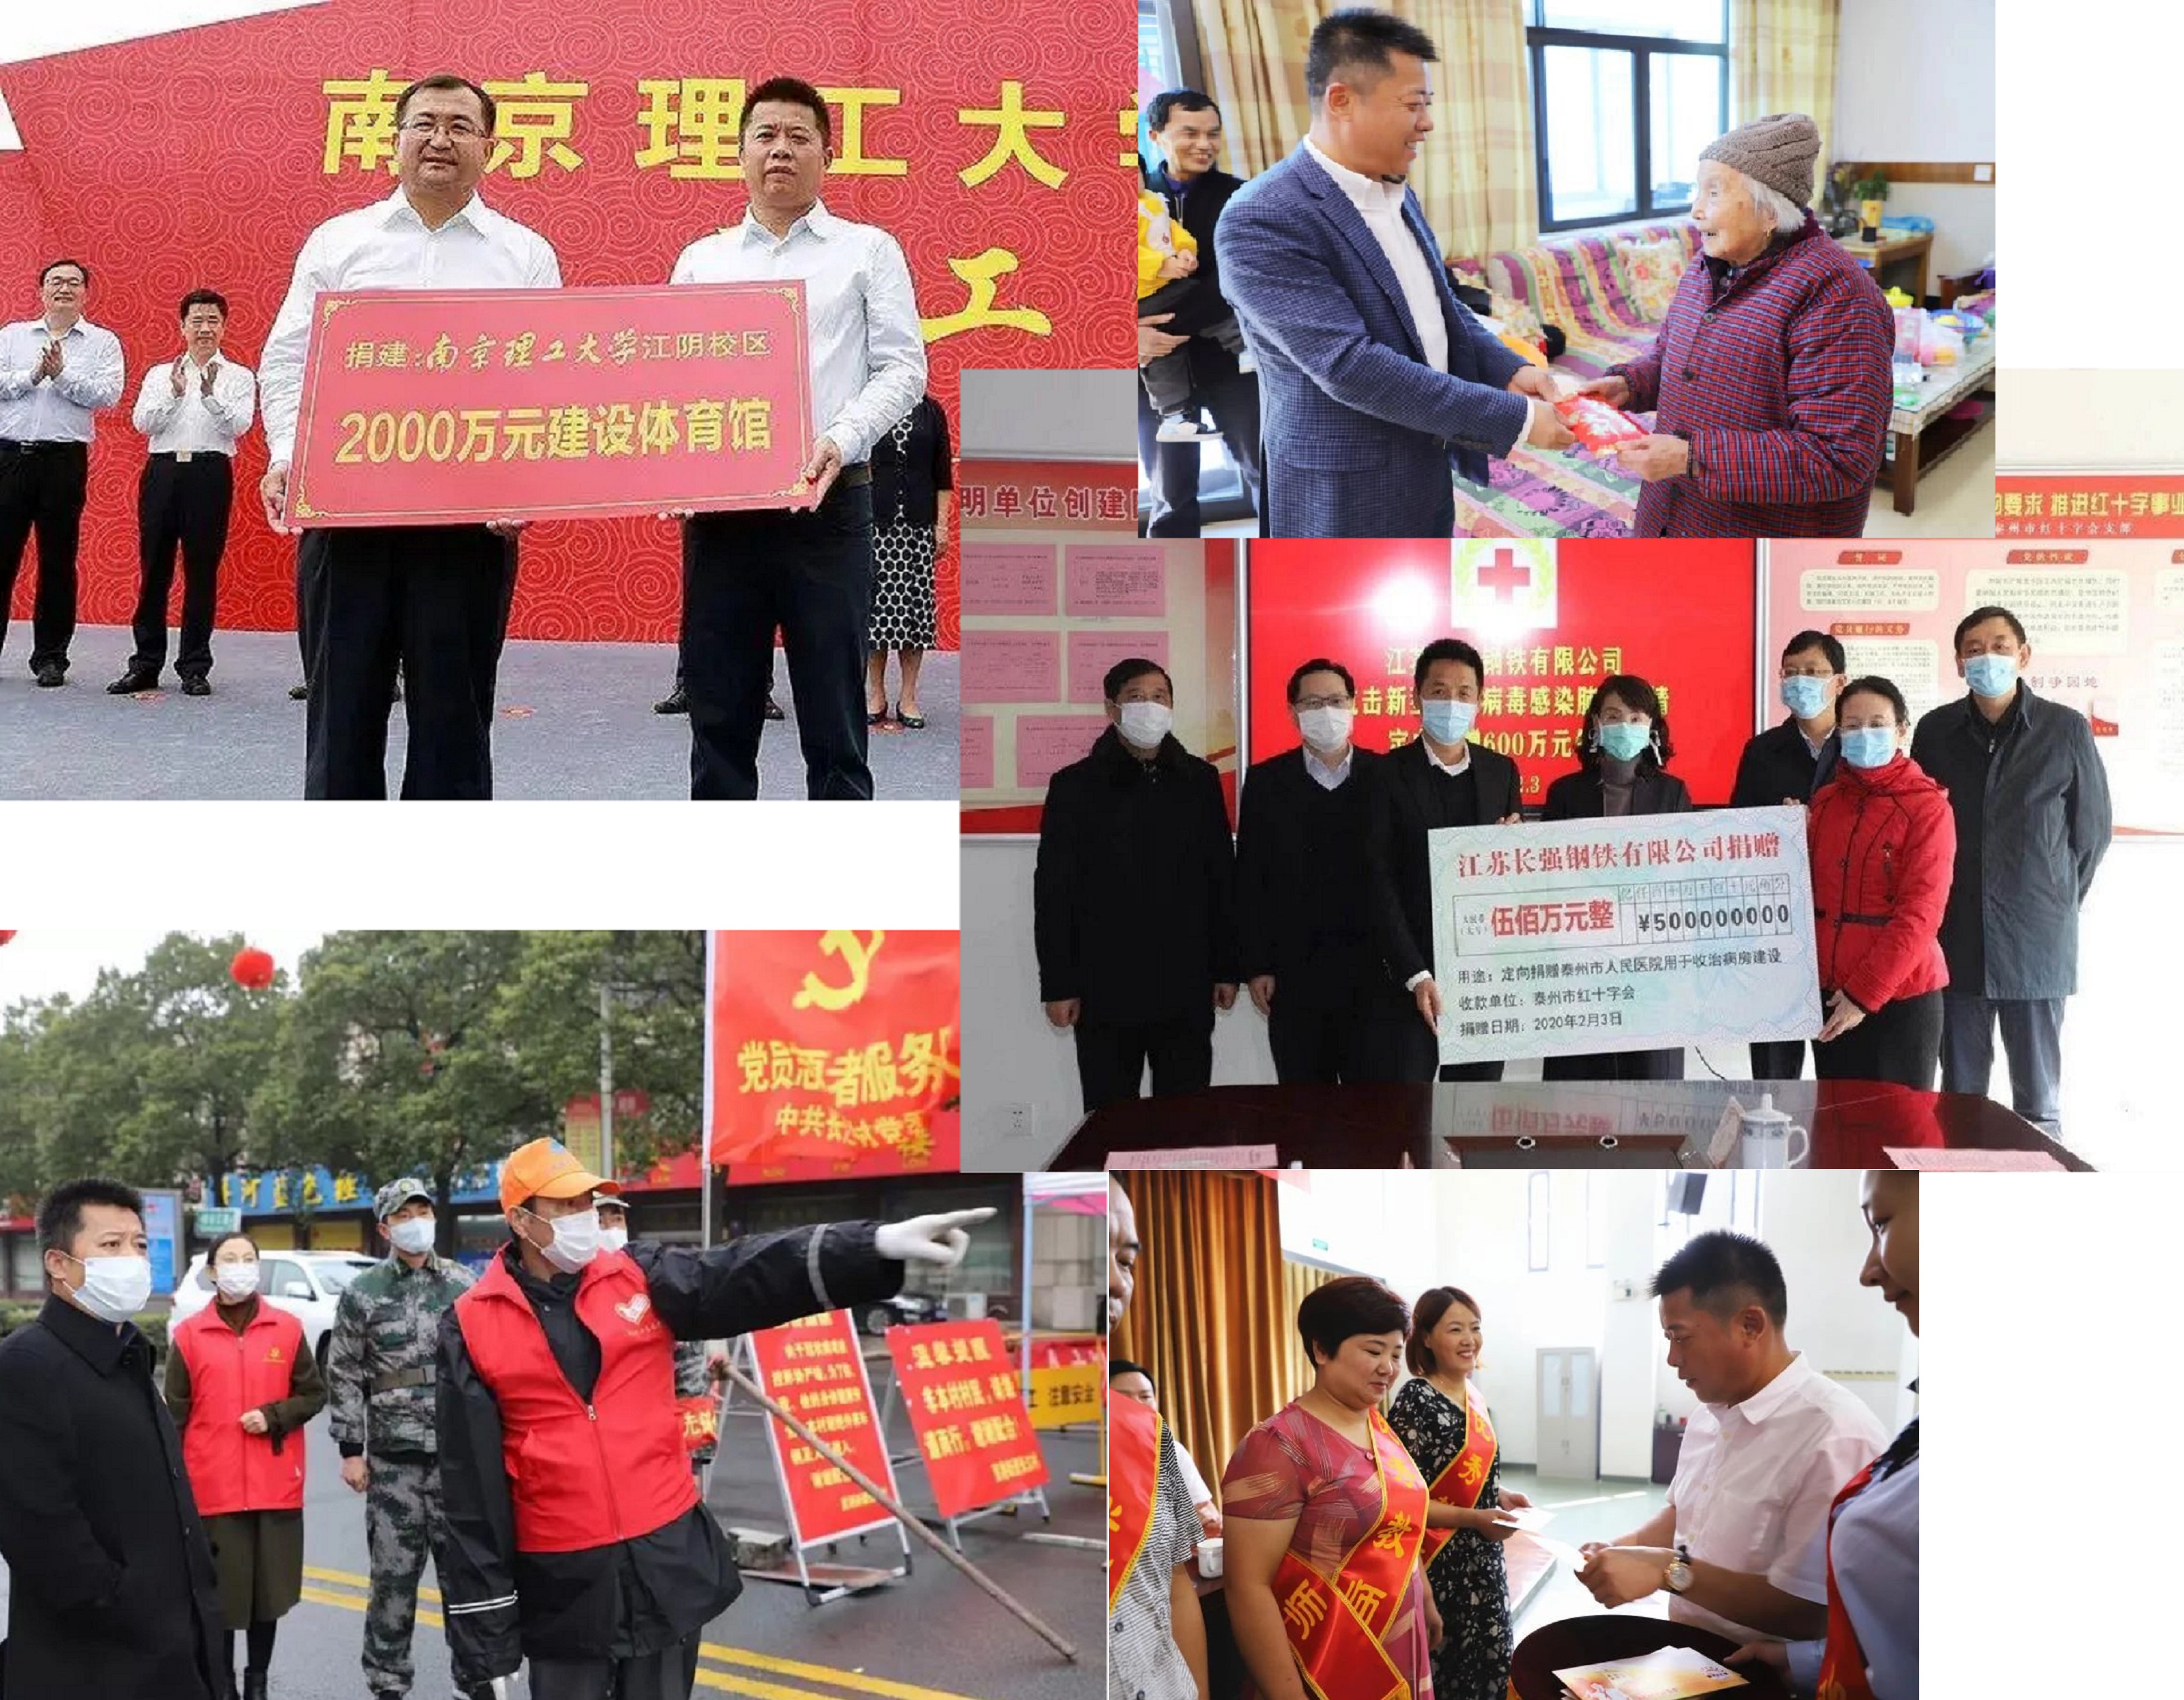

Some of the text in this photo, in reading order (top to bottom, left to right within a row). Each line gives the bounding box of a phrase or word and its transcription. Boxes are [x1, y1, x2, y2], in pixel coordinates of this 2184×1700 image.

[334, 397, 772, 463] 2000万元建设体育馆
[961, 485, 1138, 520] 明单位创建
[1388, 647, 1622, 675] 江钢铁有限公司
[1459, 832, 1780, 878] 江苏长强钢铁有限公司捐赠
[1491, 899, 1614, 937] 伍佰万元整
